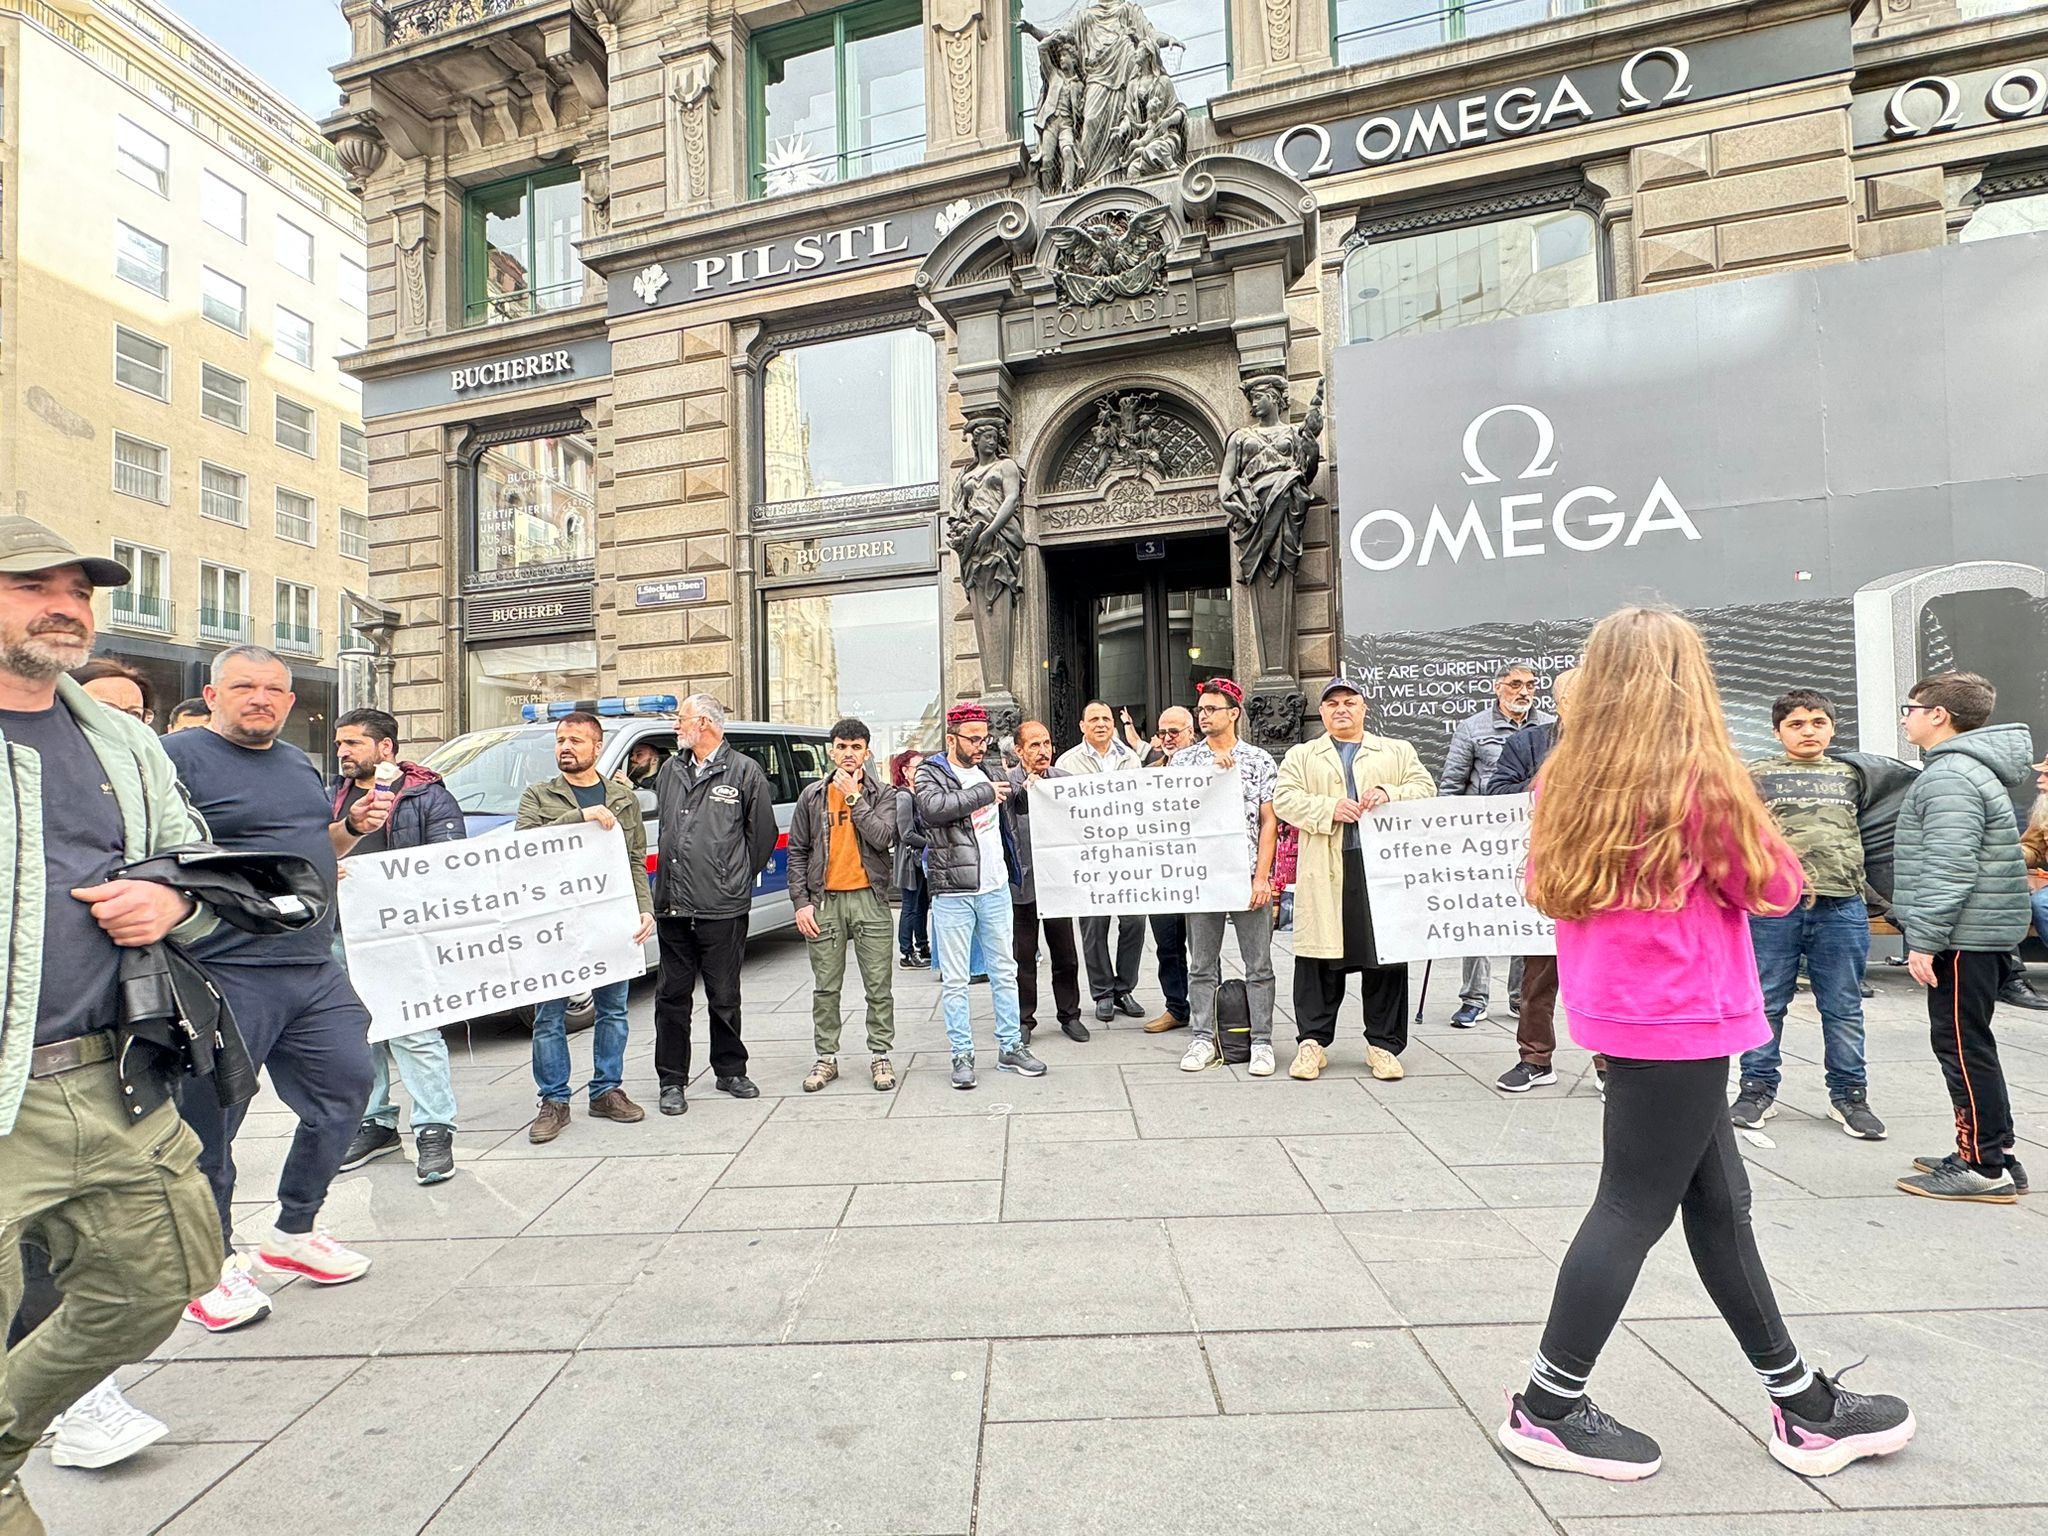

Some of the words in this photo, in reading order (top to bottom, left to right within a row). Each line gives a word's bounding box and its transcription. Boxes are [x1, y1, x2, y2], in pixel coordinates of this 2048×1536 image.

[1355, 74, 1593, 163] OMEGA
[691, 219, 909, 292] PILSTL
[1042, 292, 1189, 338] EQUITABLE
[451, 350, 571, 391] BUCHERER
[480, 504, 553, 520] ZERTIFIERTE
[1349, 475, 1703, 571] OMEGA
[797, 540, 896, 565] BUCHERER
[1145, 541, 1155, 553] 3
[492, 604, 564, 622] BUCHERER
[1358, 667, 1384, 680] WE
[1387, 665, 1419, 679] ARE
[505, 694, 530, 705] PATEK
[1388, 684, 1414, 698] WE
[1418, 681, 1465, 696] LOOK
[1380, 703, 1413, 717] YOU
[1418, 702, 1438, 715] AT
[1442, 700, 1477, 714] OUR
[1053, 778, 1137, 800] Pakistan
[1069, 801, 1144, 819] funding
[1152, 797, 1201, 812] state
[1083, 825, 1129, 840] Stop
[1136, 819, 1191, 835] using
[1373, 817, 1412, 832] Wir
[380, 857, 430, 880] We
[444, 834, 584, 870] condemn
[1080, 842, 1197, 863] afghanistan
[1379, 842, 1452, 860] offene
[559, 873, 608, 895] any
[1073, 870, 1100, 884] for
[1108, 867, 1152, 885] your
[1161, 864, 1208, 880] Drug
[1090, 885, 1200, 904] trafficking!
[436, 933, 523, 965] kinds
[536, 921, 565, 944] of
[401, 961, 608, 1021] interferences
